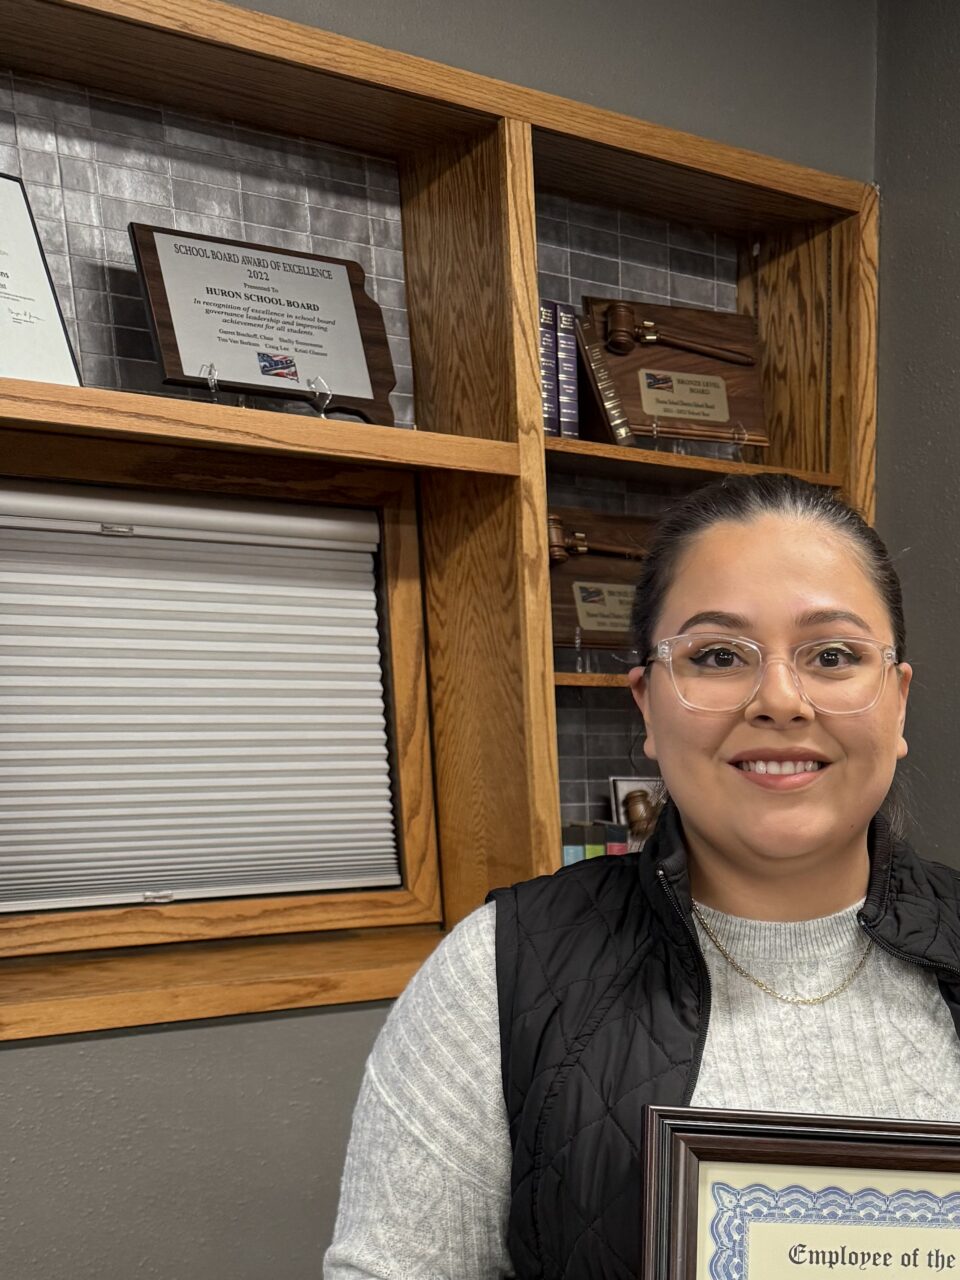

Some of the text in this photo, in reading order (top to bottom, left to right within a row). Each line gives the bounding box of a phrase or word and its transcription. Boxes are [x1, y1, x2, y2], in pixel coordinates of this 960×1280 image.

[173, 243, 334, 280] SCHOOL BOARD AWARD OF EXCELLENCE
[243, 282, 270, 292] Presented
[247, 269, 270, 281] 2022
[206, 286, 320, 312] HURON SCHOOL BOARD
[202, 300, 242, 312] recognition
[242, 304, 250, 313] of
[250, 308, 285, 318] excellence
[294, 312, 316, 322] school
[316, 316, 336, 326] board
[205, 308, 244, 319] governance
[246, 313, 281, 325] leadership
[296, 320, 328, 332] improving
[222, 318, 314, 336] achievement for all students.
[788, 1243, 893, 1270] Employee
[900, 1248, 920, 1268] of
[927, 1248, 956, 1272] the
